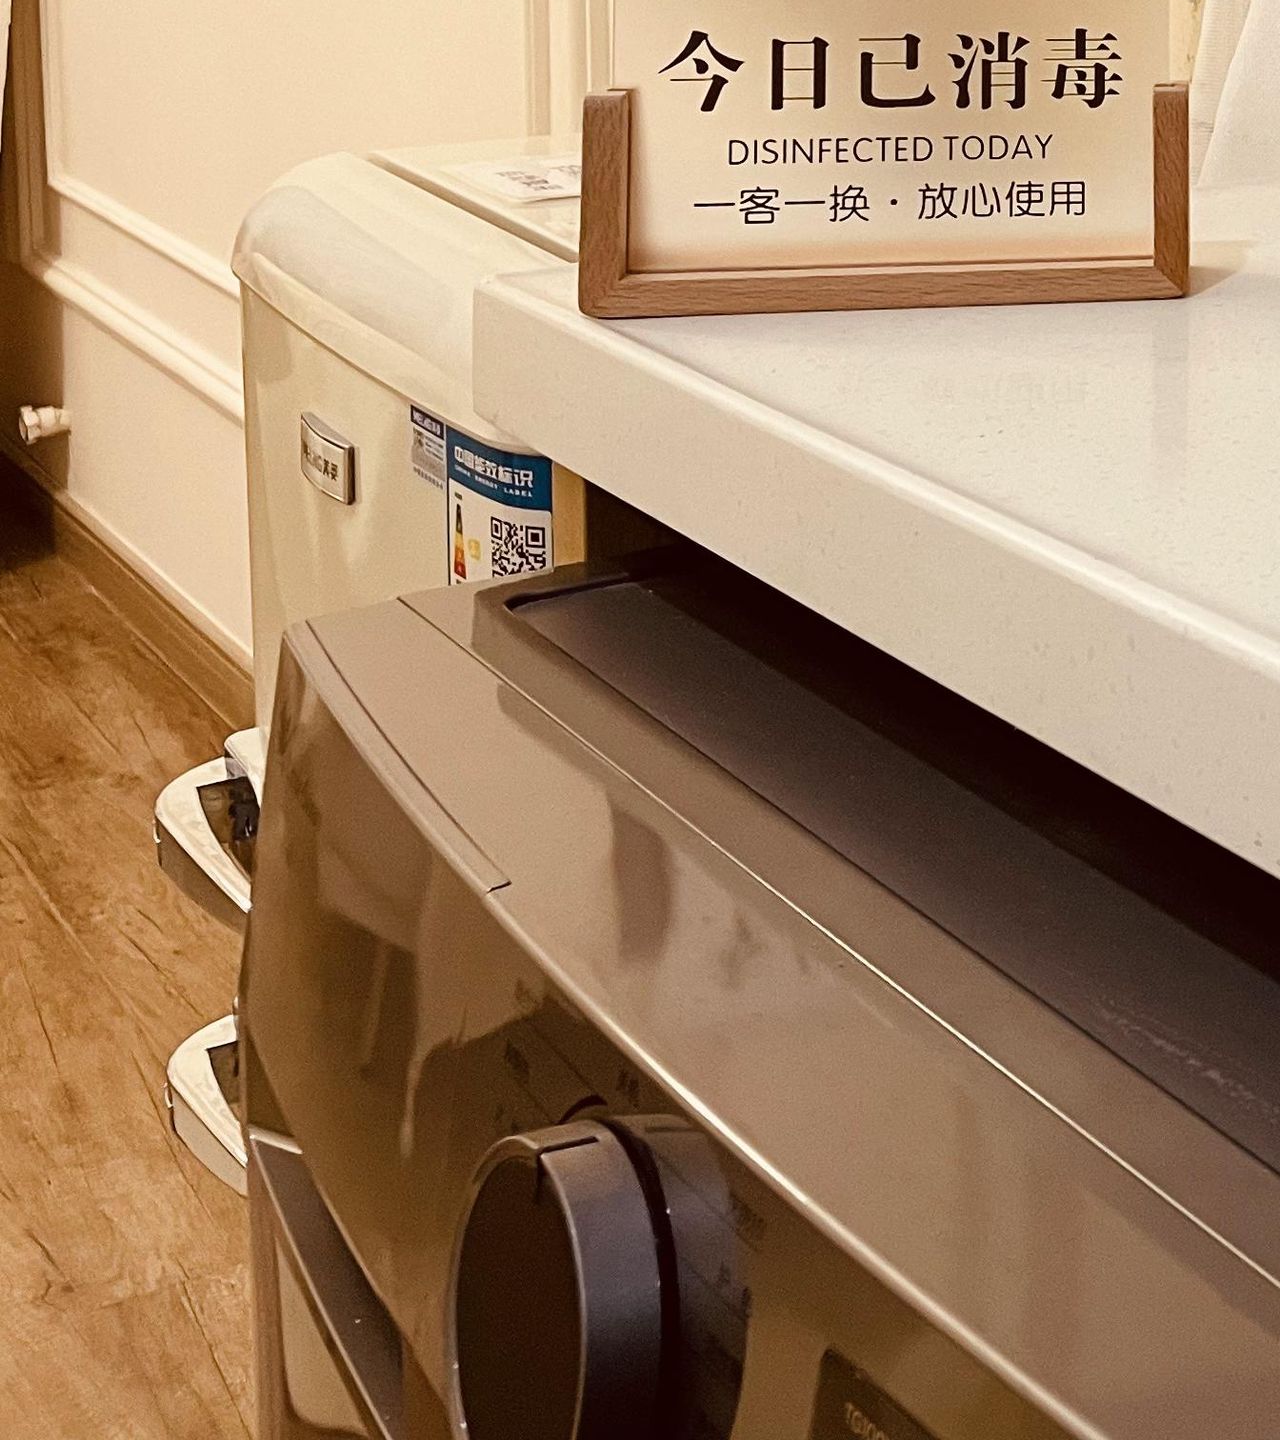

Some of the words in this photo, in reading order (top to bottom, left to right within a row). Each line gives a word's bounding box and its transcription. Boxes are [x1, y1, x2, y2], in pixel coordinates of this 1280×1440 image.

[658, 28, 1124, 112] 今日已消毒
[728, 136, 934, 166] DISINFECTED
[946, 133, 1054, 161] TODAY
